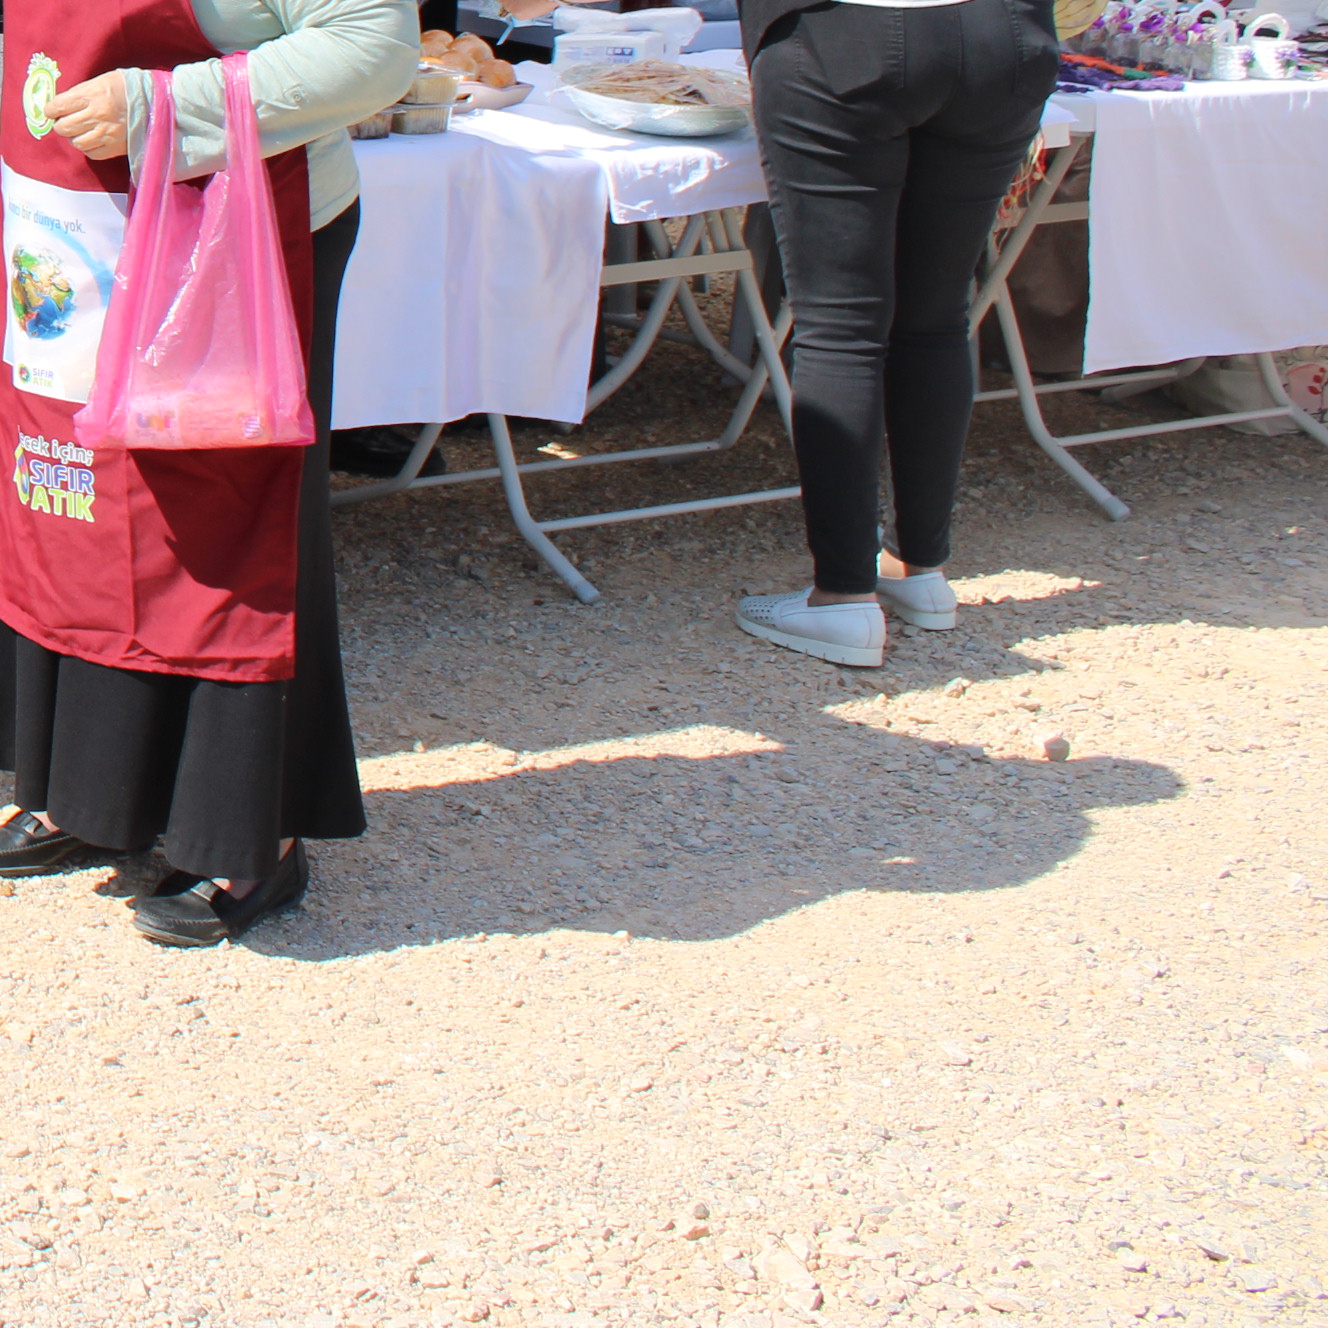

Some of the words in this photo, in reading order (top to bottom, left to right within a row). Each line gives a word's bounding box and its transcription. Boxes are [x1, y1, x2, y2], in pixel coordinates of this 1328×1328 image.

[33, 209, 61, 231] dünya
[63, 219, 86, 234] yok.
[32, 367, 54, 380] SIFIR
[32, 377, 53, 389] ATIK
[29, 458, 95, 495] SIFIR
[30, 485, 96, 523] ATIK
